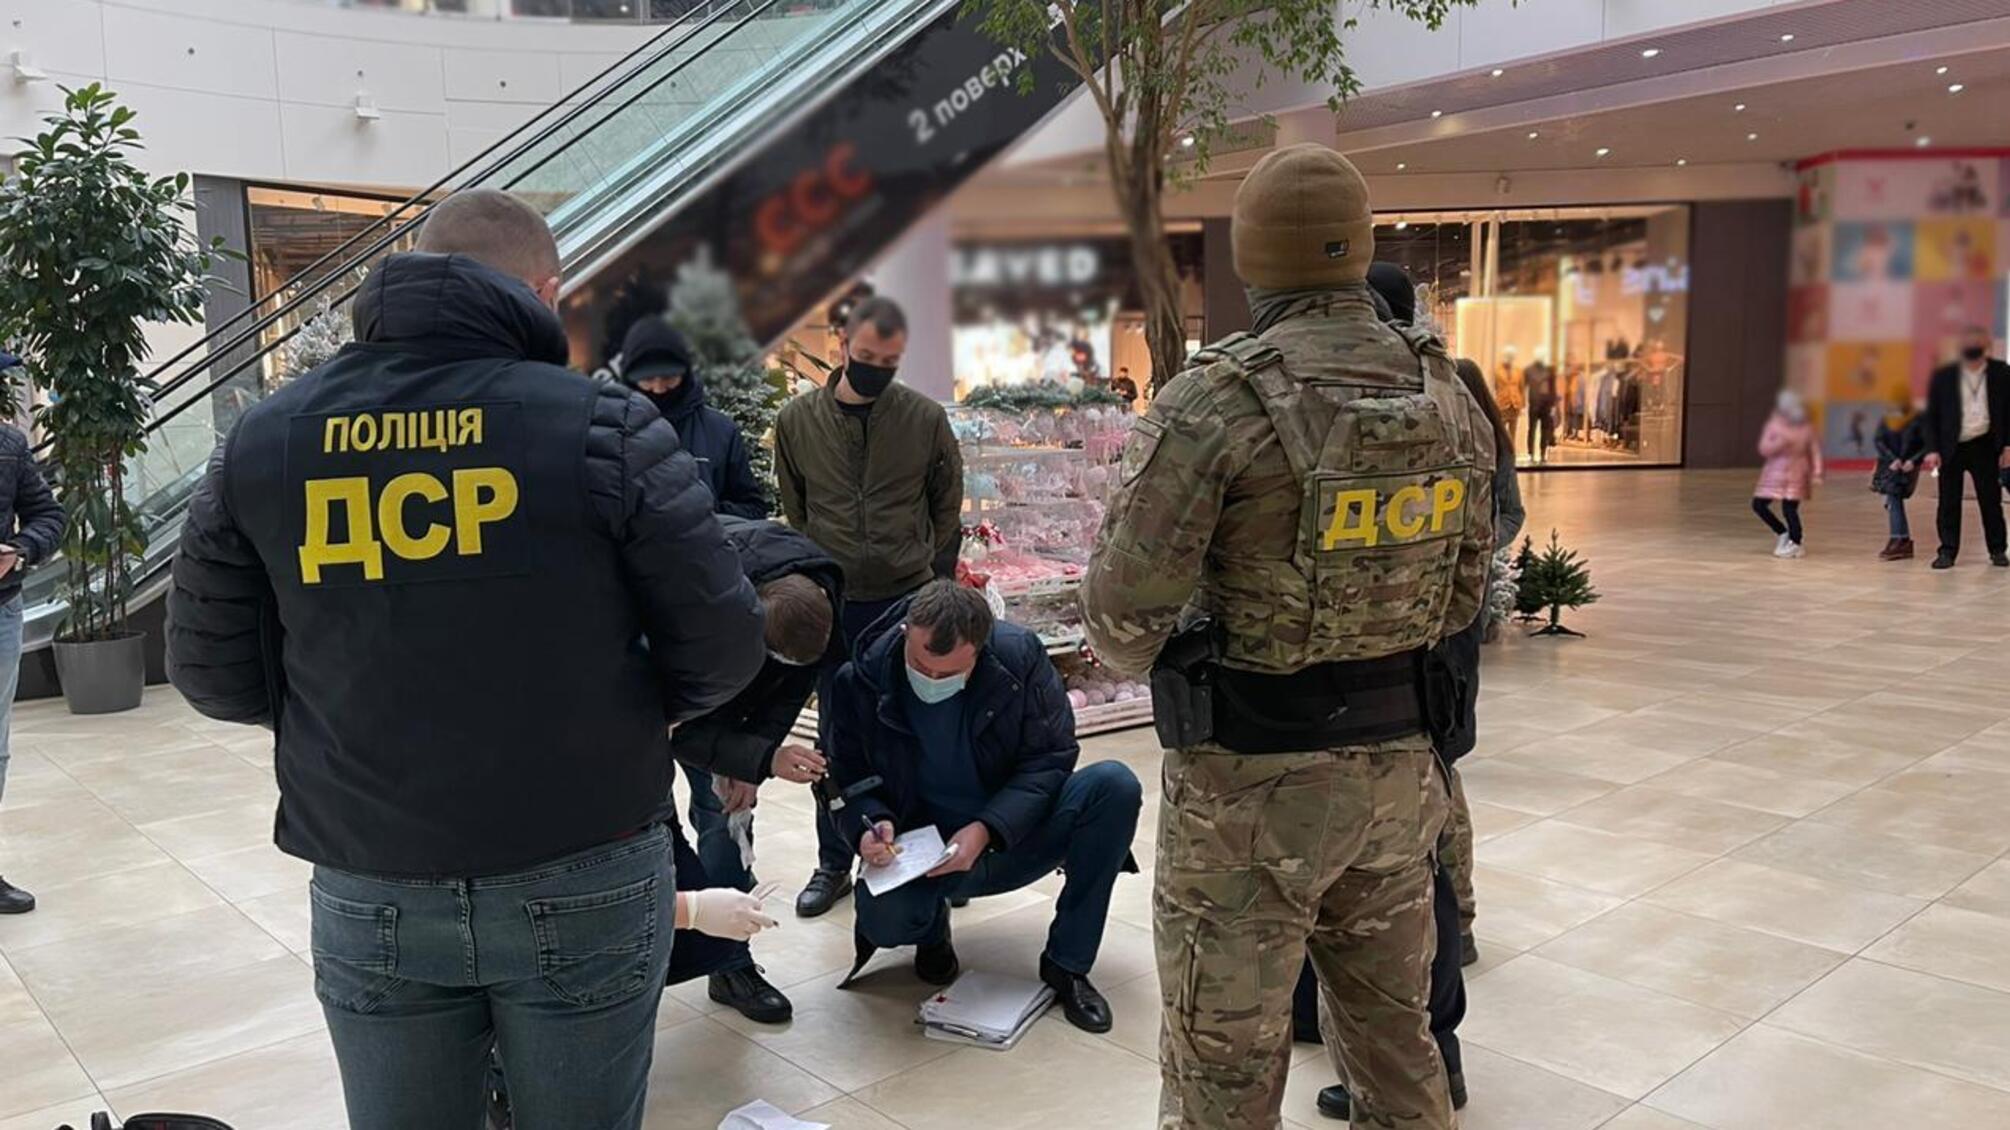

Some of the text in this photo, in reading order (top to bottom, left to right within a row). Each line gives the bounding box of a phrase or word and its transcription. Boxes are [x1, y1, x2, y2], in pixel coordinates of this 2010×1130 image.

[907, 46, 1027, 145] 2 поверх
[324, 407, 483, 453] ПОЛІЦІЯ
[298, 466, 519, 584] ДСР
[1322, 478, 1466, 551] ДСР
